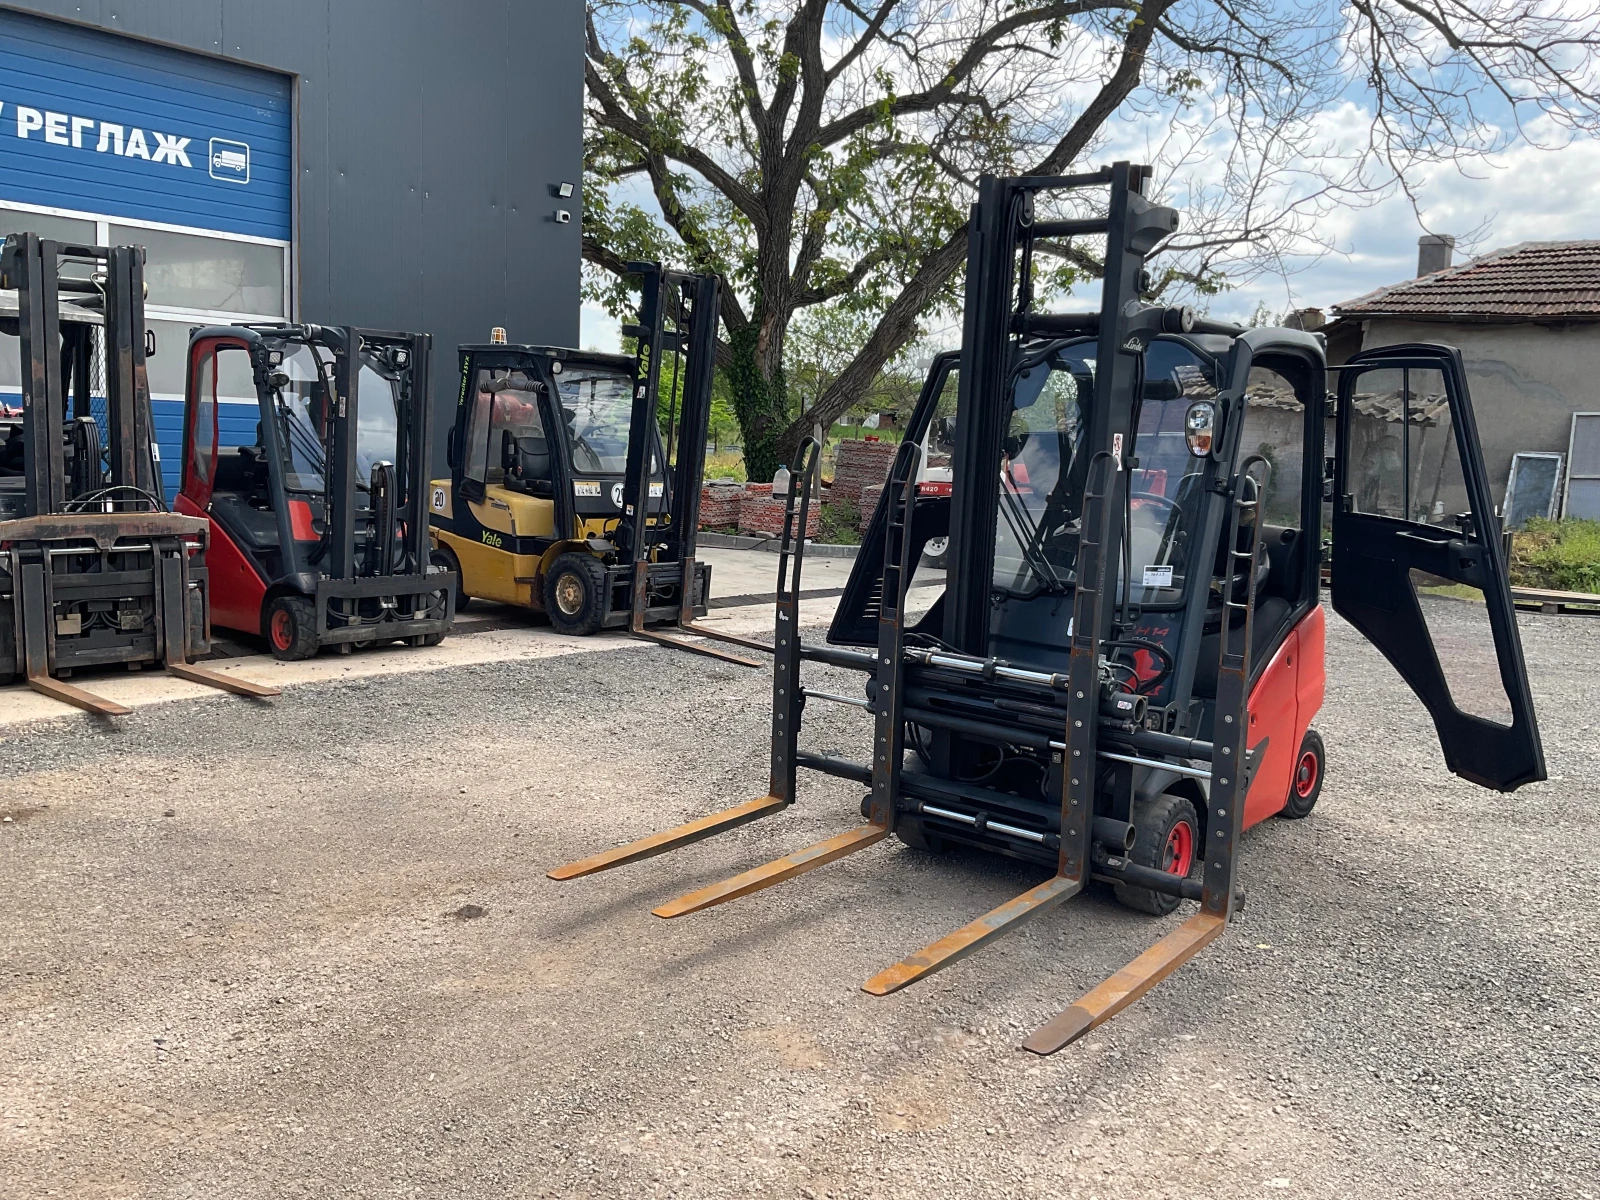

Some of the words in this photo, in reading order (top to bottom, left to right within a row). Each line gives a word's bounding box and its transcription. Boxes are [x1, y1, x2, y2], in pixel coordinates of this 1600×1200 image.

[17, 106, 192, 168] РЕГЛАЖ
[638, 344, 650, 379] Yale
[434, 491, 444, 507] 20
[614, 487, 625, 504] 2
[482, 530, 502, 547] Yale
